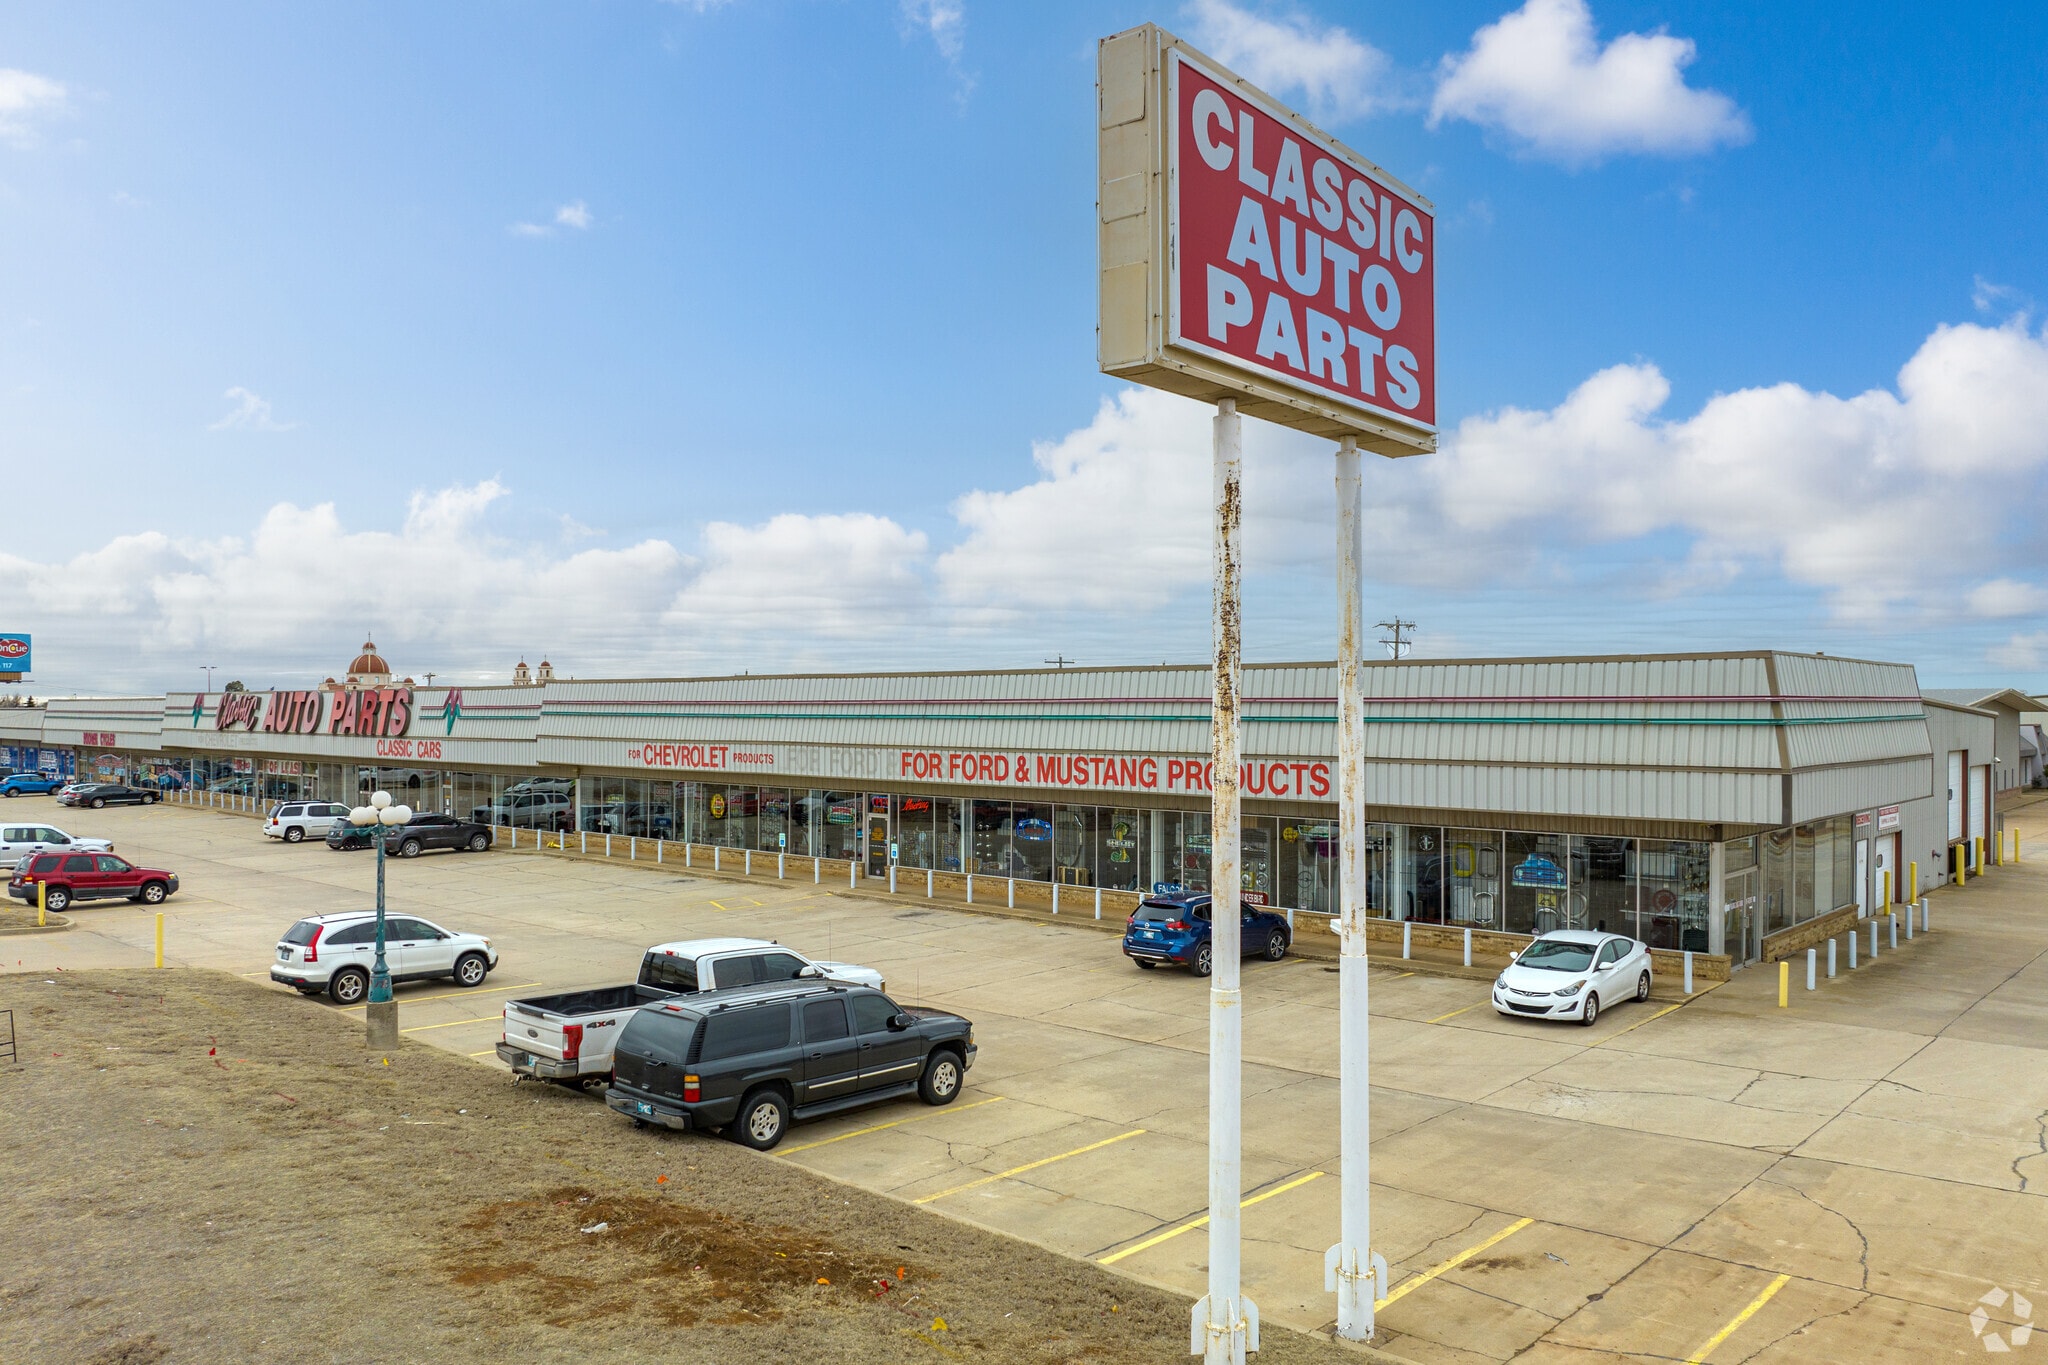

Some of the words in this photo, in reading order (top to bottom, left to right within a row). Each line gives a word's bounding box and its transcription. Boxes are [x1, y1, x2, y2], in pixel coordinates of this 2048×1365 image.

[1192, 89, 1424, 274] CLASSIC
[1226, 195, 1402, 331] AUTO
[1206, 263, 1421, 410] PARTS
[215, 692, 258, 730] Classic
[262, 690, 321, 734] AUTO
[328, 688, 412, 737] PARTS
[377, 739, 412, 757] CLASSIC
[417, 740, 442, 759] CARS
[628, 749, 641, 759] FOR
[643, 743, 729, 768] CHEVROLET
[733, 752, 774, 765] PRODUCTS
[901, 752, 942, 779] FOR
[949, 754, 1009, 781] FORD
[1015, 755, 1030, 783] &
[1036, 755, 1157, 788] MUSTANG
[1168, 760, 1330, 797] PRUCTS
